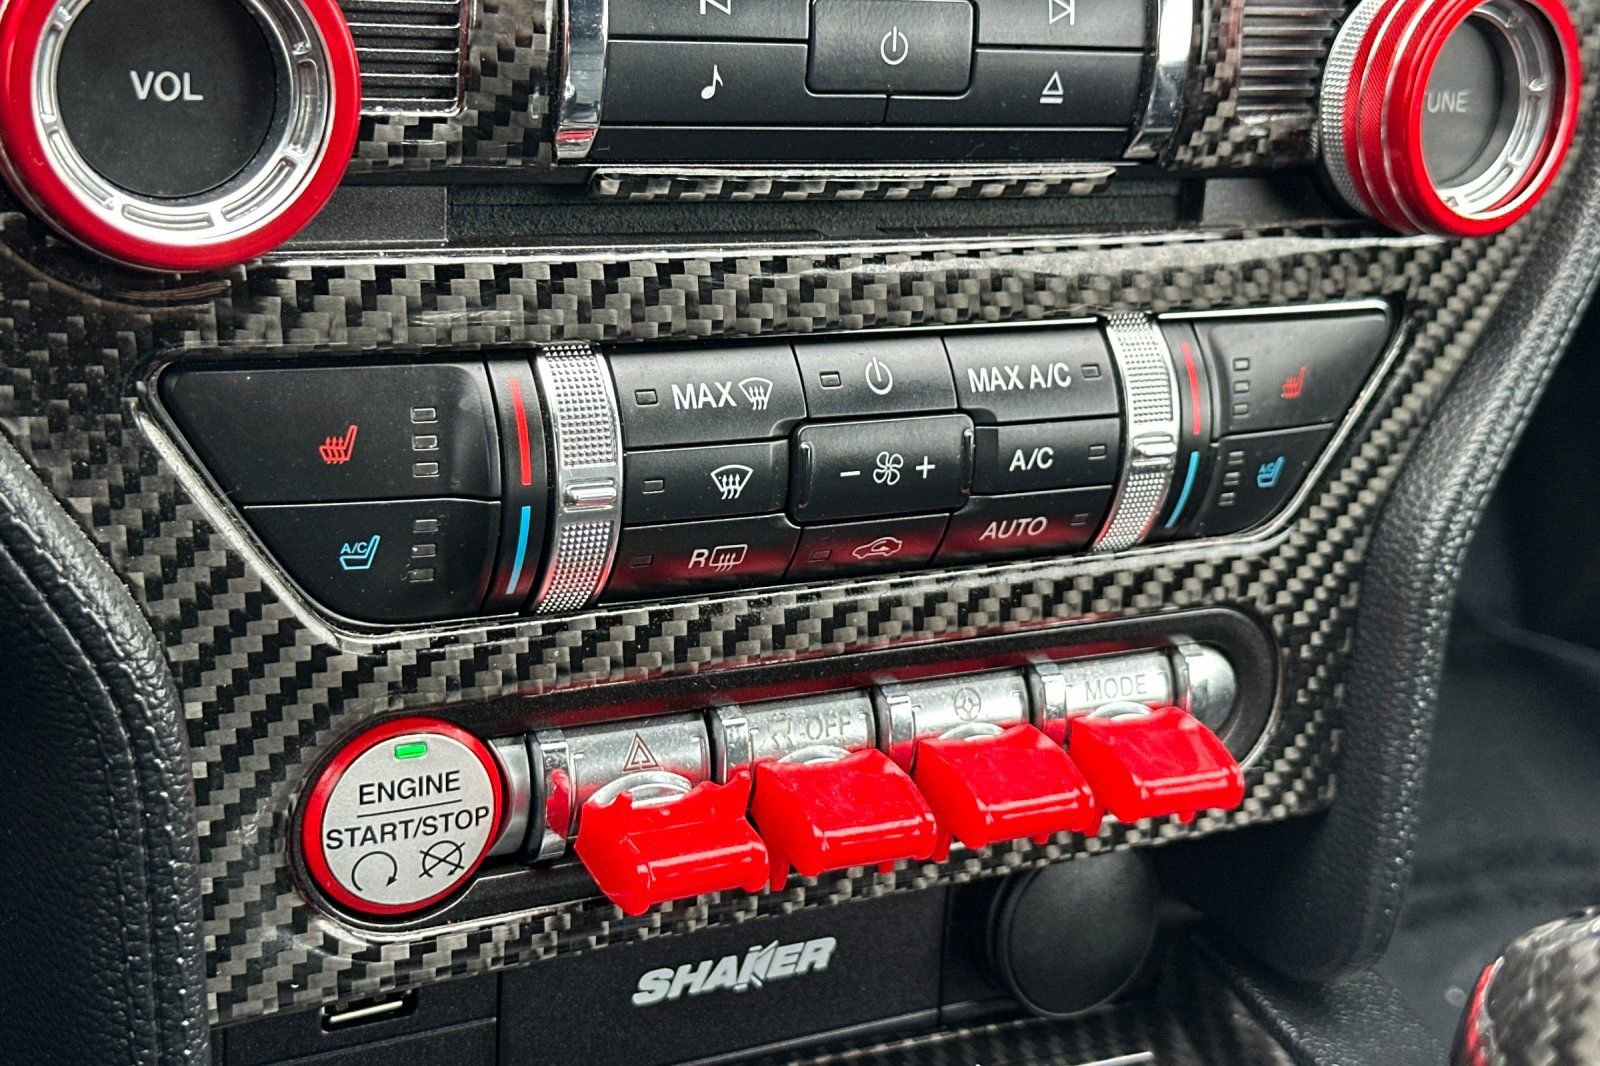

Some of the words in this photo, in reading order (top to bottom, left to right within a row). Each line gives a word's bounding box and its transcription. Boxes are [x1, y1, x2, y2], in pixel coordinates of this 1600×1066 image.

[130, 70, 204, 101] VOL
[1424, 90, 1469, 113] UNE
[967, 364, 1024, 393] MAX
[1029, 362, 1072, 389] A/C
[671, 381, 737, 410] MAX
[1008, 446, 1055, 472] A/C
[978, 516, 1048, 541] AUTO
[340, 541, 368, 554] A/C
[688, 548, 710, 569] R
[1084, 673, 1148, 702] MODE
[805, 709, 852, 740] OFF
[358, 770, 461, 806] ENGINE
[325, 805, 490, 850] START/STOP
[631, 936, 837, 1005] SHAKER
